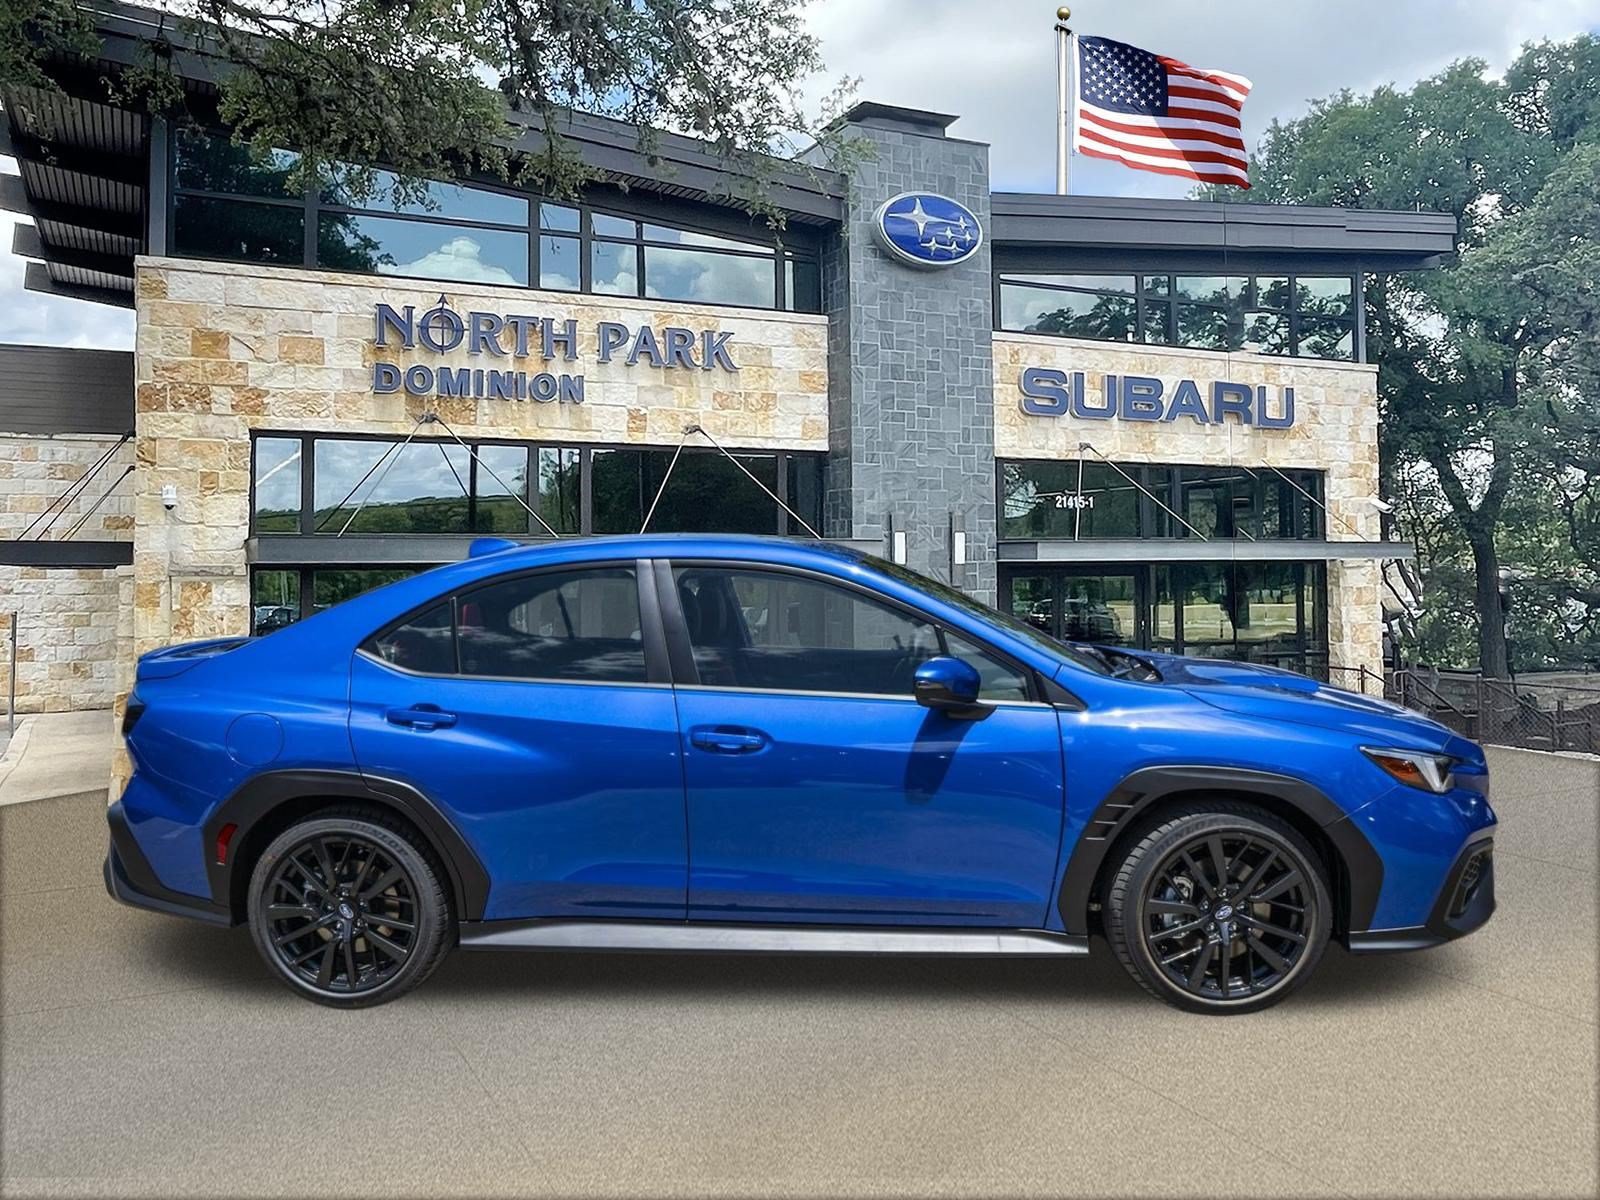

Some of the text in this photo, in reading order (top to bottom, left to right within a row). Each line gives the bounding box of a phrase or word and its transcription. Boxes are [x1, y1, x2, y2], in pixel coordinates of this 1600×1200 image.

[375, 295, 741, 372] NORTH PARK
[373, 362, 585, 403] DOMINION
[1018, 367, 1295, 429] SUBARU
[1055, 495, 1094, 508] 21415-1
